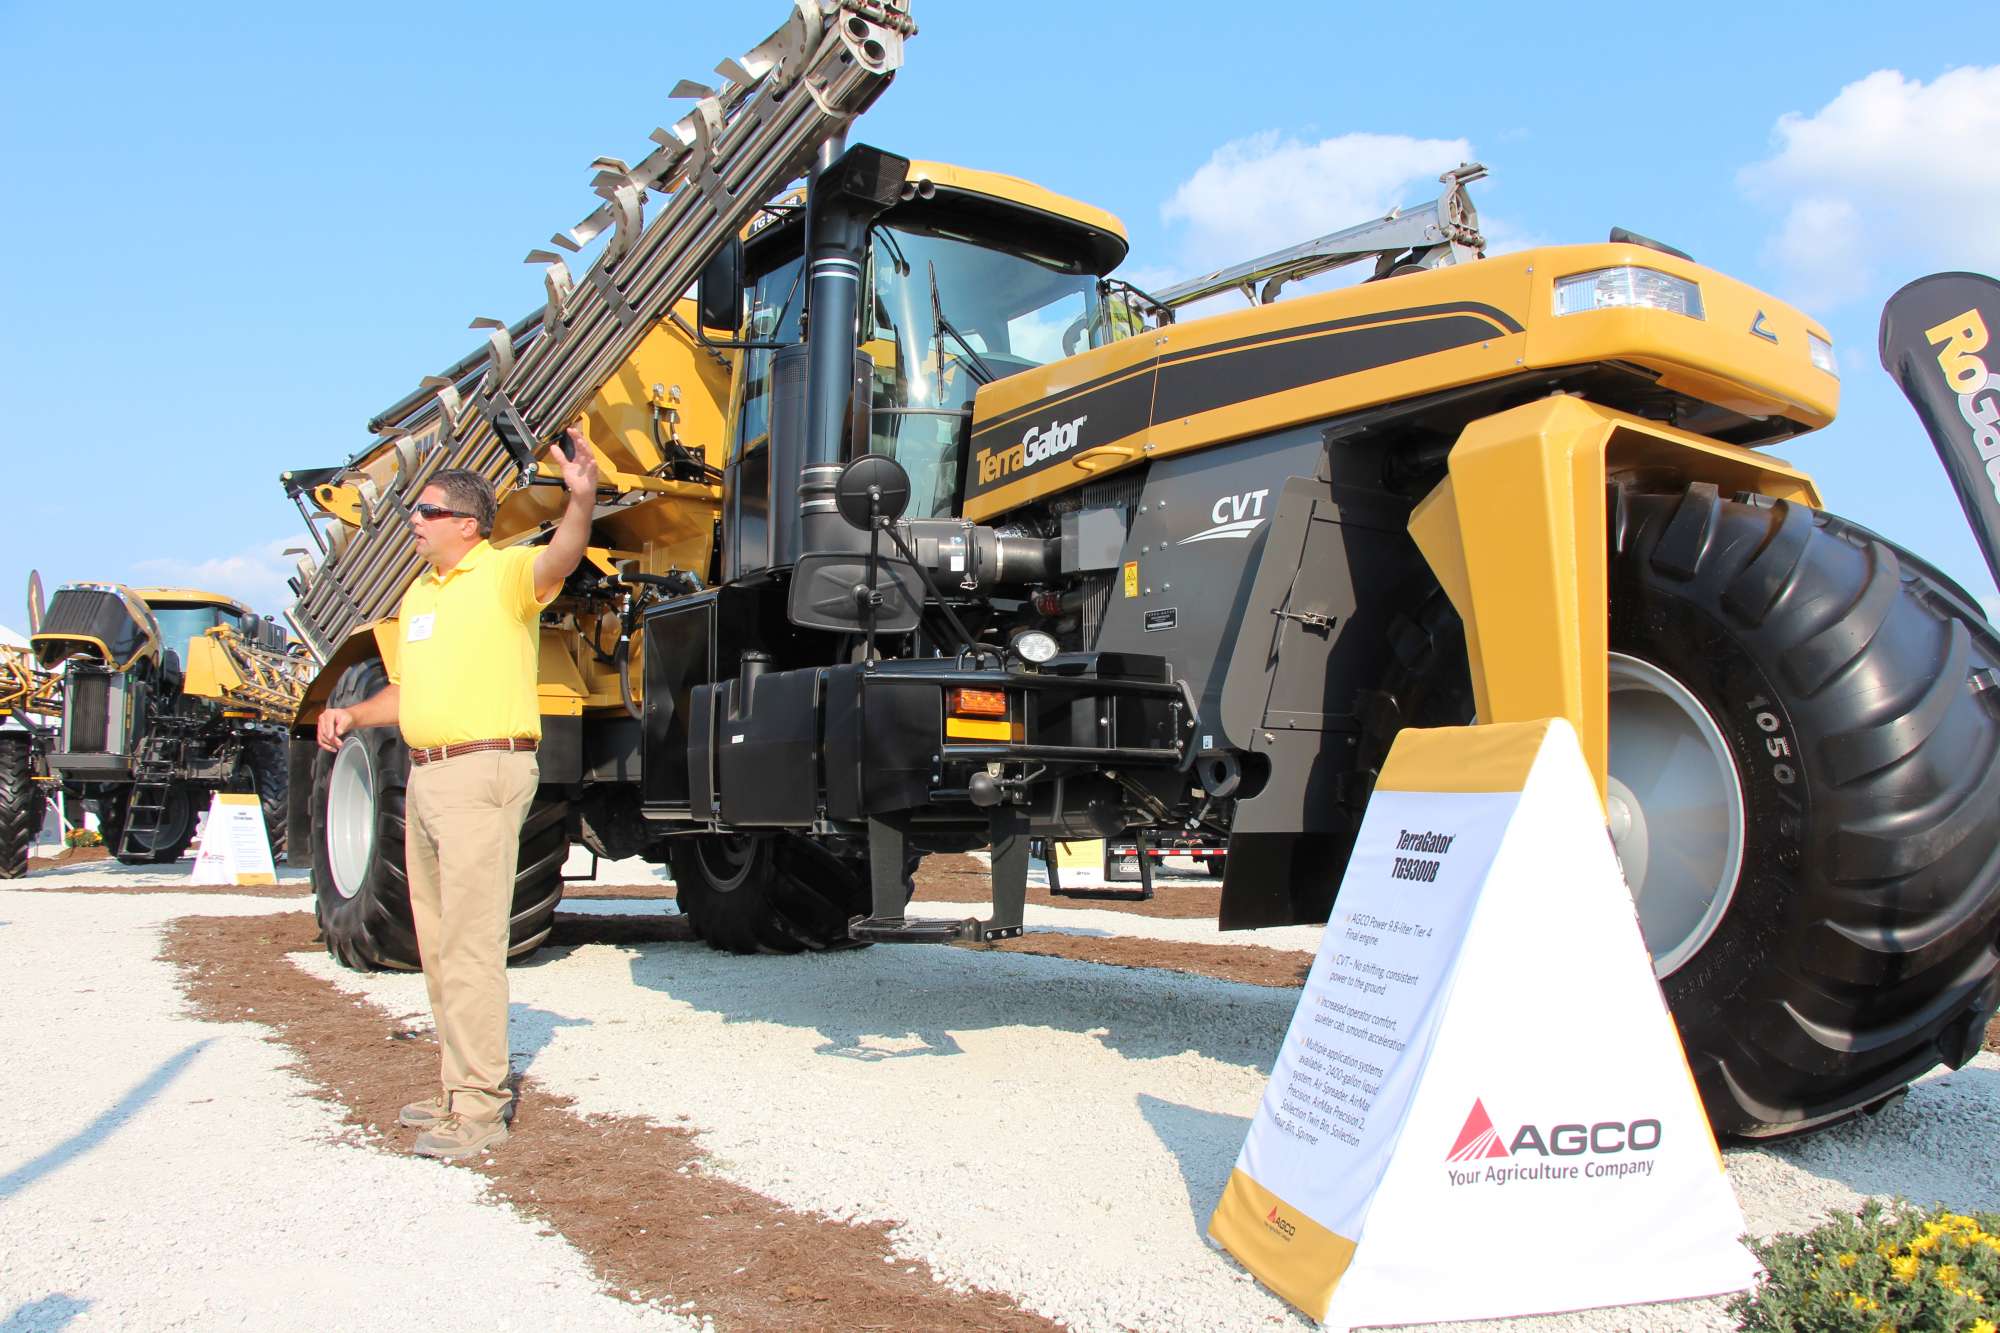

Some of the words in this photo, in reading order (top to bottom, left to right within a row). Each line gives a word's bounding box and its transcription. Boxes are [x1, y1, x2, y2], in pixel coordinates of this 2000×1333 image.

[976, 416, 1085, 486] TerraGator
[1212, 489, 1269, 524] CVT
[1396, 829, 1454, 854] TerraGator
[1391, 857, 1440, 883] TG9300B
[1345, 928, 1359, 942] Final
[1358, 932, 1380, 947] engine
[1351, 913, 1370, 927] AGCO
[1370, 917, 1388, 930] Power
[1388, 920, 1413, 936] 9.8-liter
[1413, 924, 1427, 938] Tier
[1336, 954, 1351, 966] CVT
[1353, 960, 1363, 971] No
[1386, 969, 1419, 986] consistent
[1329, 972, 1348, 983] power
[1354, 978, 1365, 989] the
[1363, 981, 1387, 996] ground
[1320, 998, 1348, 1014] Increased
[1346, 1006, 1372, 1022] operator
[1314, 1014, 1334, 1025] quieter
[1346, 1025, 1369, 1041] smooth
[1367, 1033, 1406, 1052] acceleration
[1298, 1055, 1323, 1072] available
[1306, 1037, 1328, 1055] Multiple
[1327, 1048, 1359, 1068] application
[1358, 1059, 1384, 1078] systems
[1313, 1078, 1323, 1090] Air
[1306, 1112, 1320, 1127] Twin
[1333, 1105, 1360, 1126] Precision
[1295, 1126, 1319, 1145] Spinner
[1509, 1118, 1661, 1157] AGCO
[1448, 1169, 1480, 1187] Your
[1485, 1163, 1579, 1186] Agriculture
[1585, 1159, 1655, 1179] Company
[1275, 1216, 1296, 1237] AGCO
